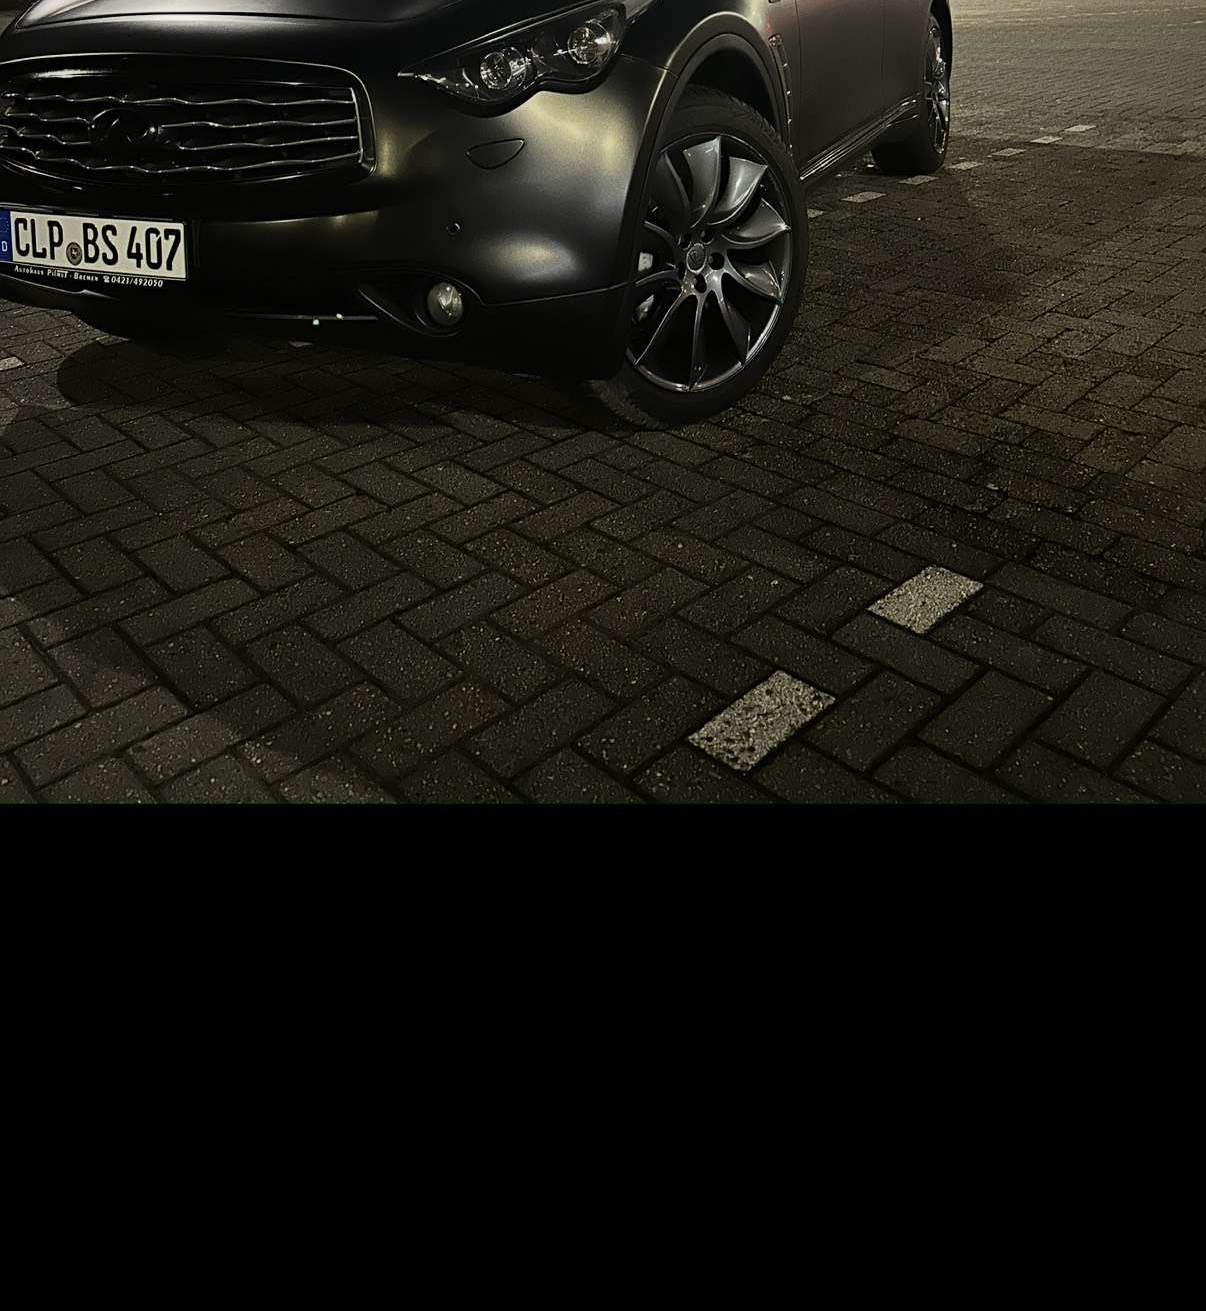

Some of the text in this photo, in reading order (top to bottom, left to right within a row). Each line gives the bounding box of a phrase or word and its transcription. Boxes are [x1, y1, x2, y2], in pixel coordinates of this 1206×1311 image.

[1, 240, 8, 252] D
[14, 217, 181, 271] CLP BS 407
